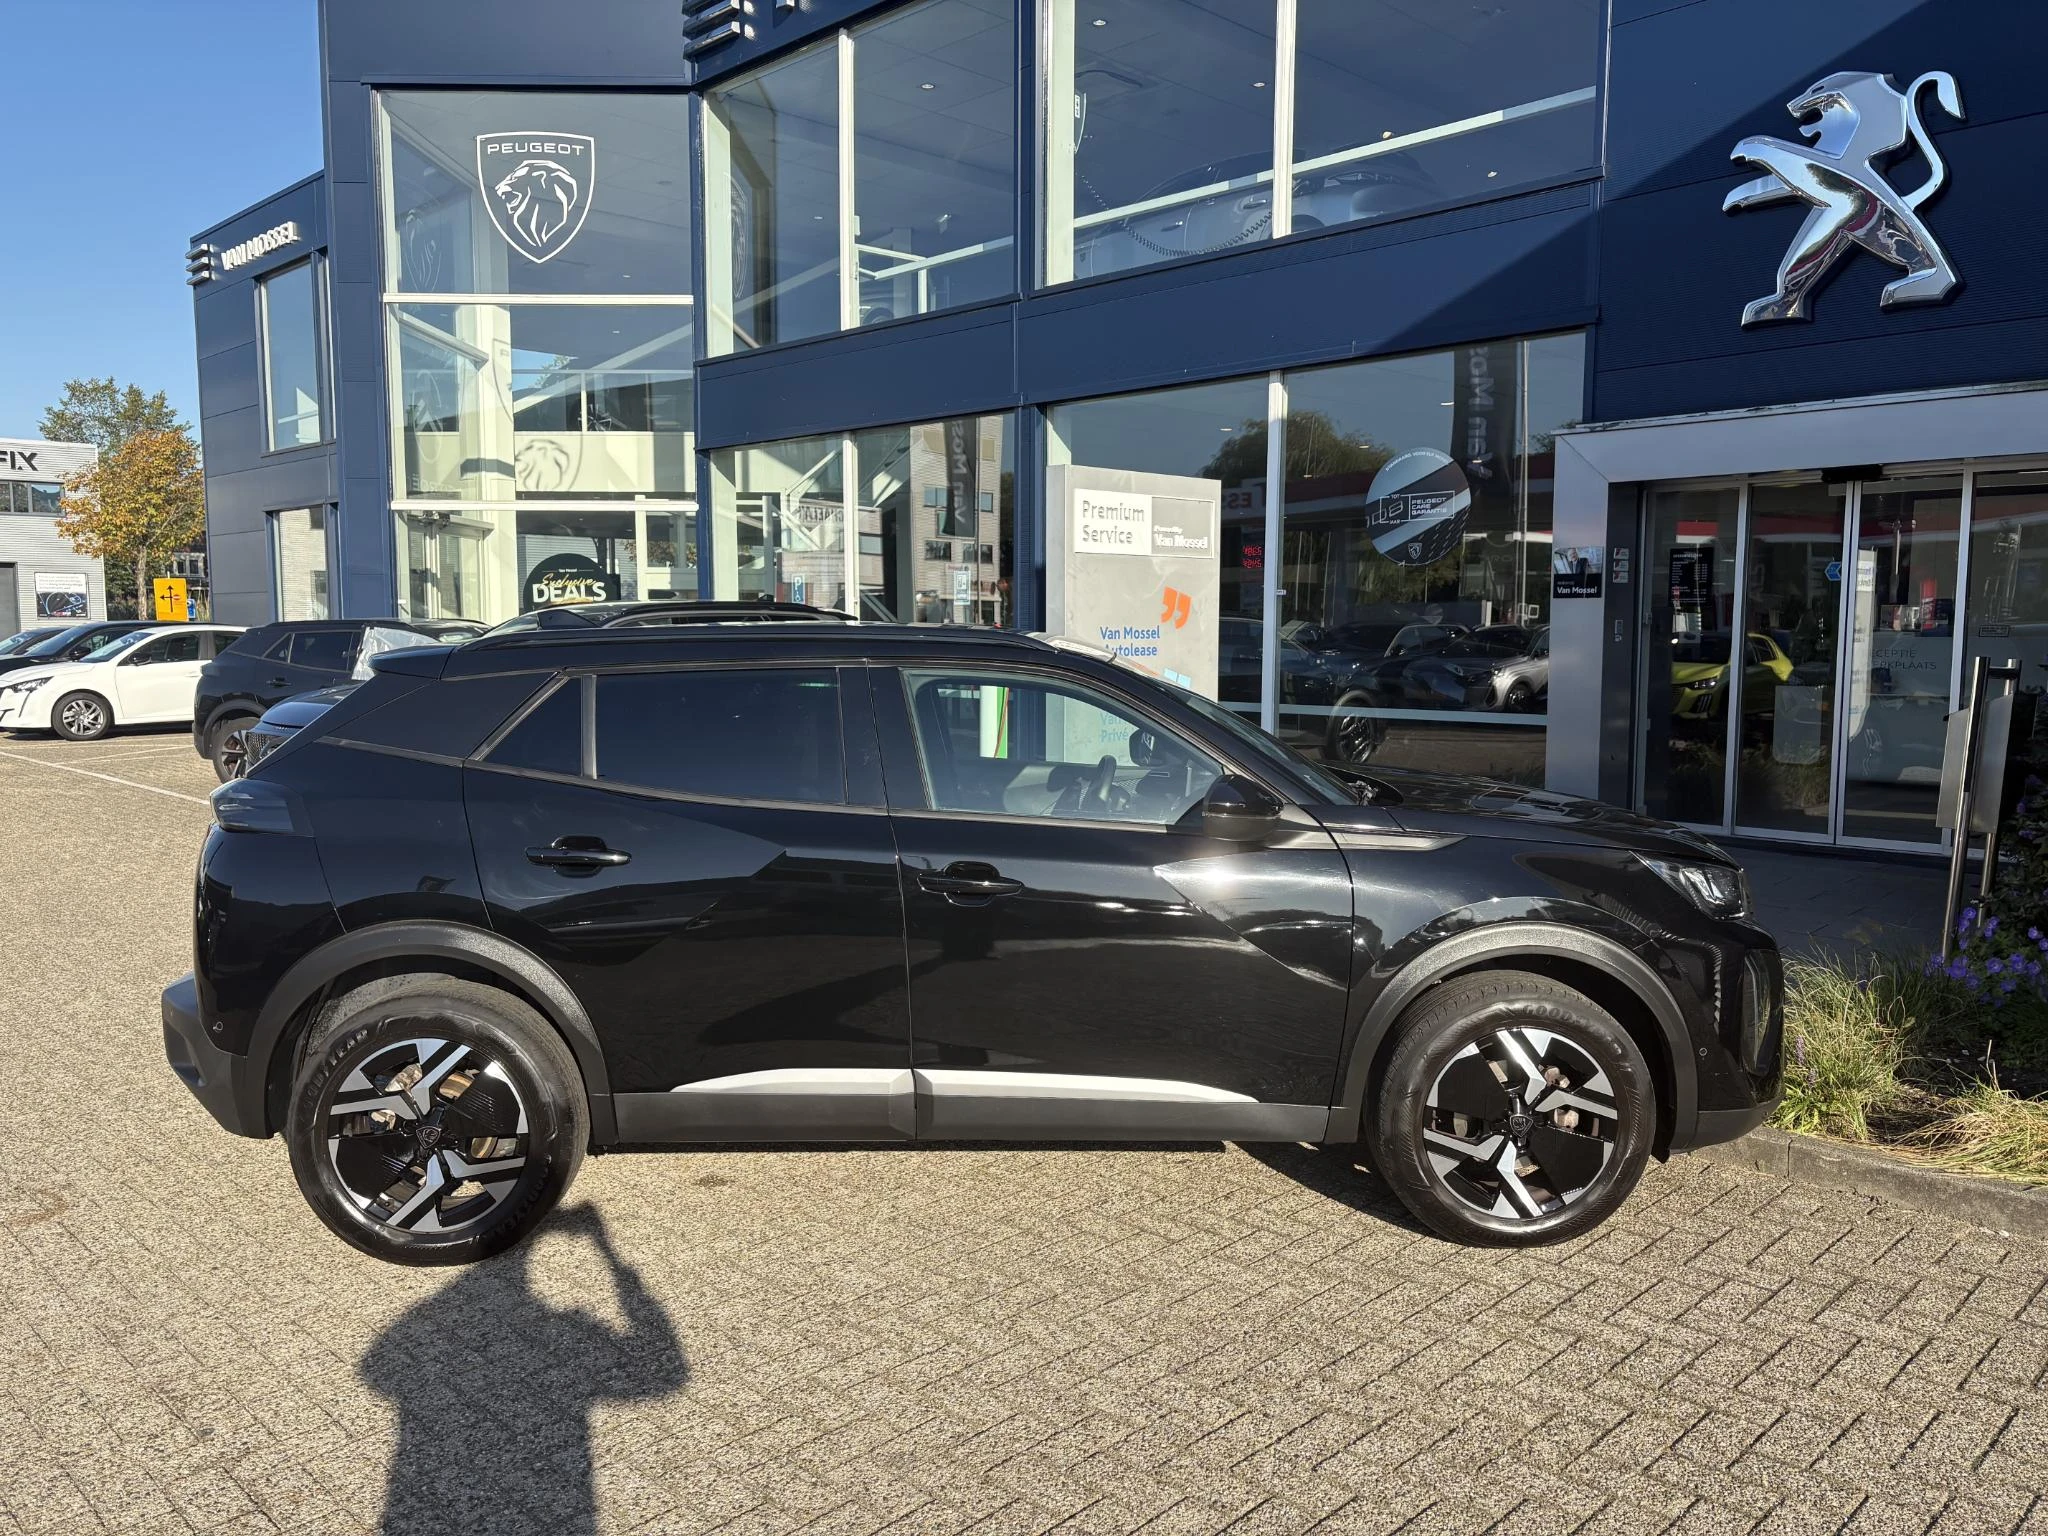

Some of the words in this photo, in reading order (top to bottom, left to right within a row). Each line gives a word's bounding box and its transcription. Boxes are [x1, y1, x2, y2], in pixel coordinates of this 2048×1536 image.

[487, 142, 584, 156] PEUGEOT
[221, 243, 247, 271] VAN
[246, 221, 299, 260] MOSSEL
[1412, 497, 1447, 505] PEUGEOT
[1082, 500, 1145, 522] Premium
[1412, 508, 1447, 516] GARANTIE
[1082, 524, 1134, 545] Service
[1153, 533, 1174, 547] Van
[1174, 534, 1208, 550] Mossel
[542, 573, 597, 588] Exclusive
[532, 581, 607, 603] DEALS
[1557, 586, 1571, 594] Van
[1572, 585, 1598, 594] Mossel
[1100, 626, 1120, 640] Van
[1124, 625, 1160, 640] Mossel
[1106, 643, 1158, 656] utolease
[1872, 648, 1917, 658] ECEPTIE
[1872, 661, 1937, 671] ERKPLAATS
[1101, 727, 1129, 742] Privé
